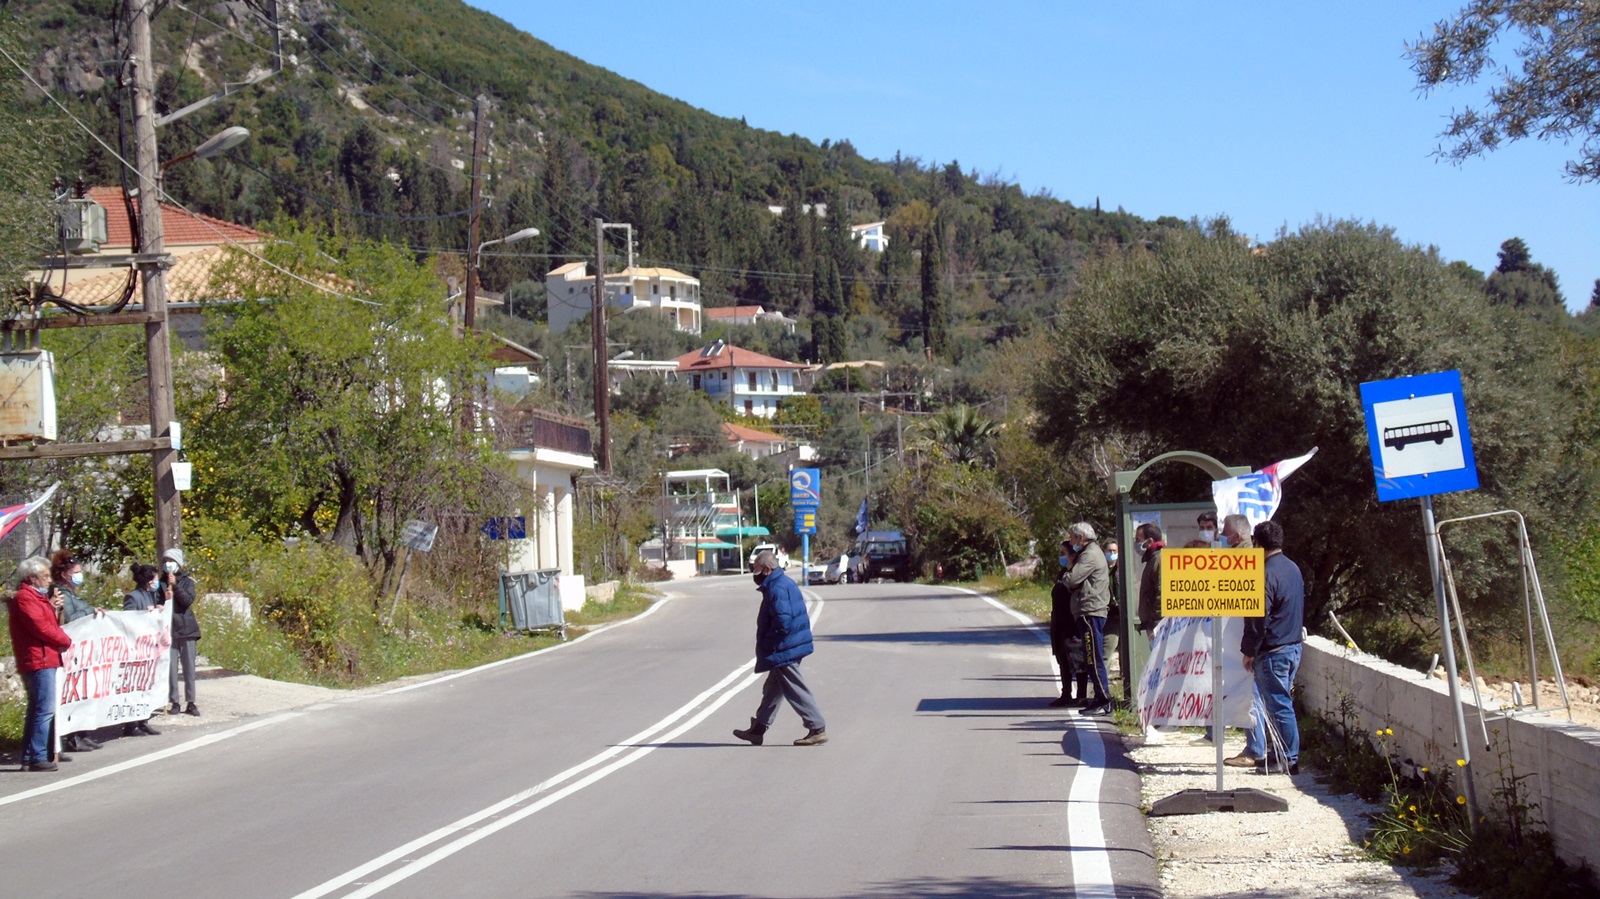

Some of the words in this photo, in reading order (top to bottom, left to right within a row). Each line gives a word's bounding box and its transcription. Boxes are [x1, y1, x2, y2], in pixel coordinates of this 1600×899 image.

[1169, 554, 1257, 571] ΠΡΟΣΟΧΗ
[1170, 579, 1210, 592] ΕΙΣΟΔΟΣ
[1218, 579, 1256, 592] ΕΞΟΔΟΣ
[1166, 598, 1205, 611] ΒΑΡΕΩΝ
[1206, 598, 1260, 611] ΟΧΗΜΑΤΩΝ
[60, 669, 89, 706] ΟΧΙ
